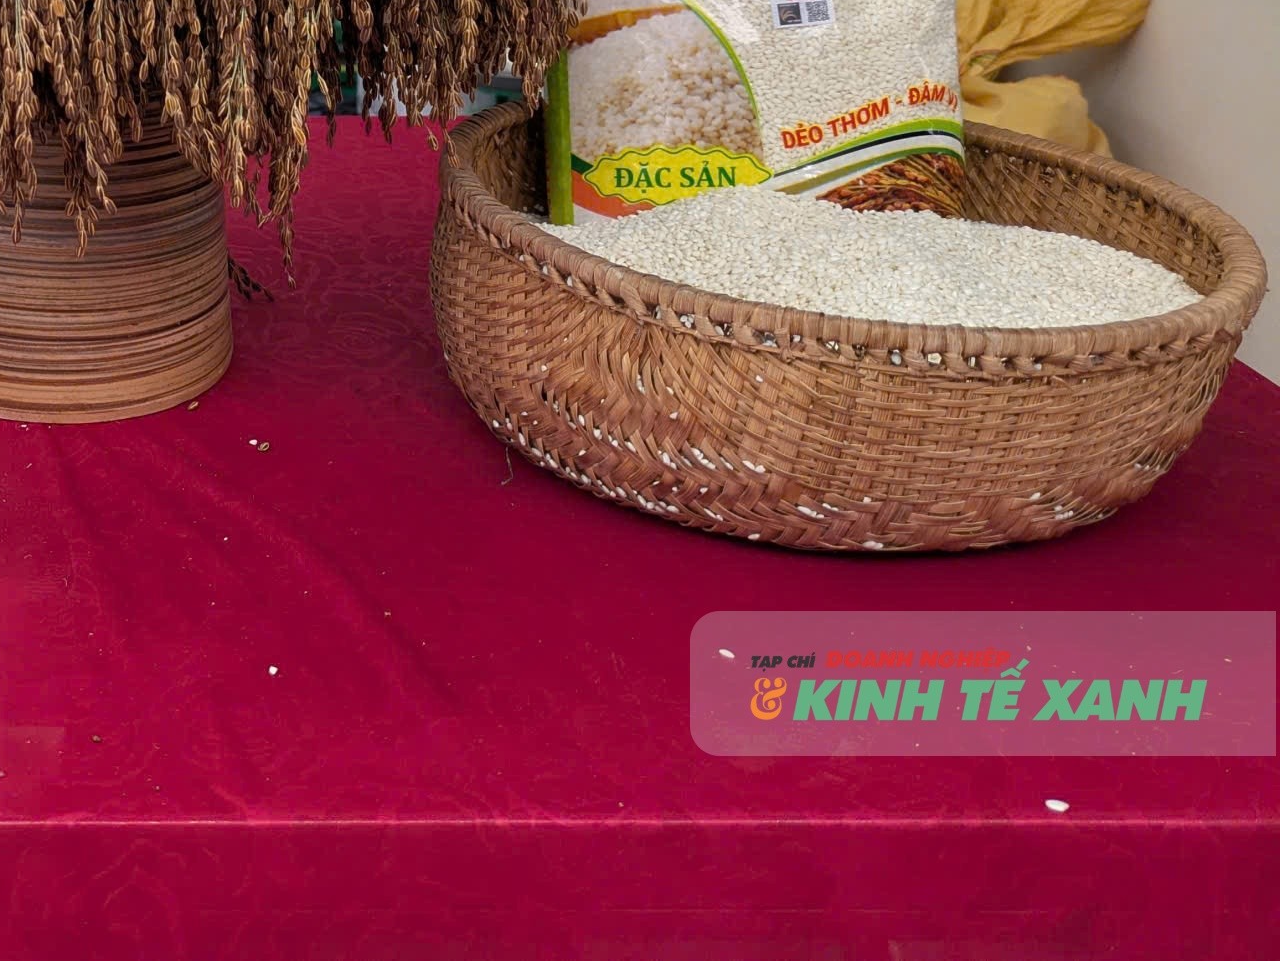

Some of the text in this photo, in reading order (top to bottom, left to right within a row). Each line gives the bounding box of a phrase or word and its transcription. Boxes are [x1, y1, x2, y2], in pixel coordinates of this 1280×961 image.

[781, 122, 824, 149] DẺO
[827, 95, 891, 138] THƠM
[908, 81, 946, 107] ĐẬM
[614, 160, 736, 194] ĐẶC SẢN
